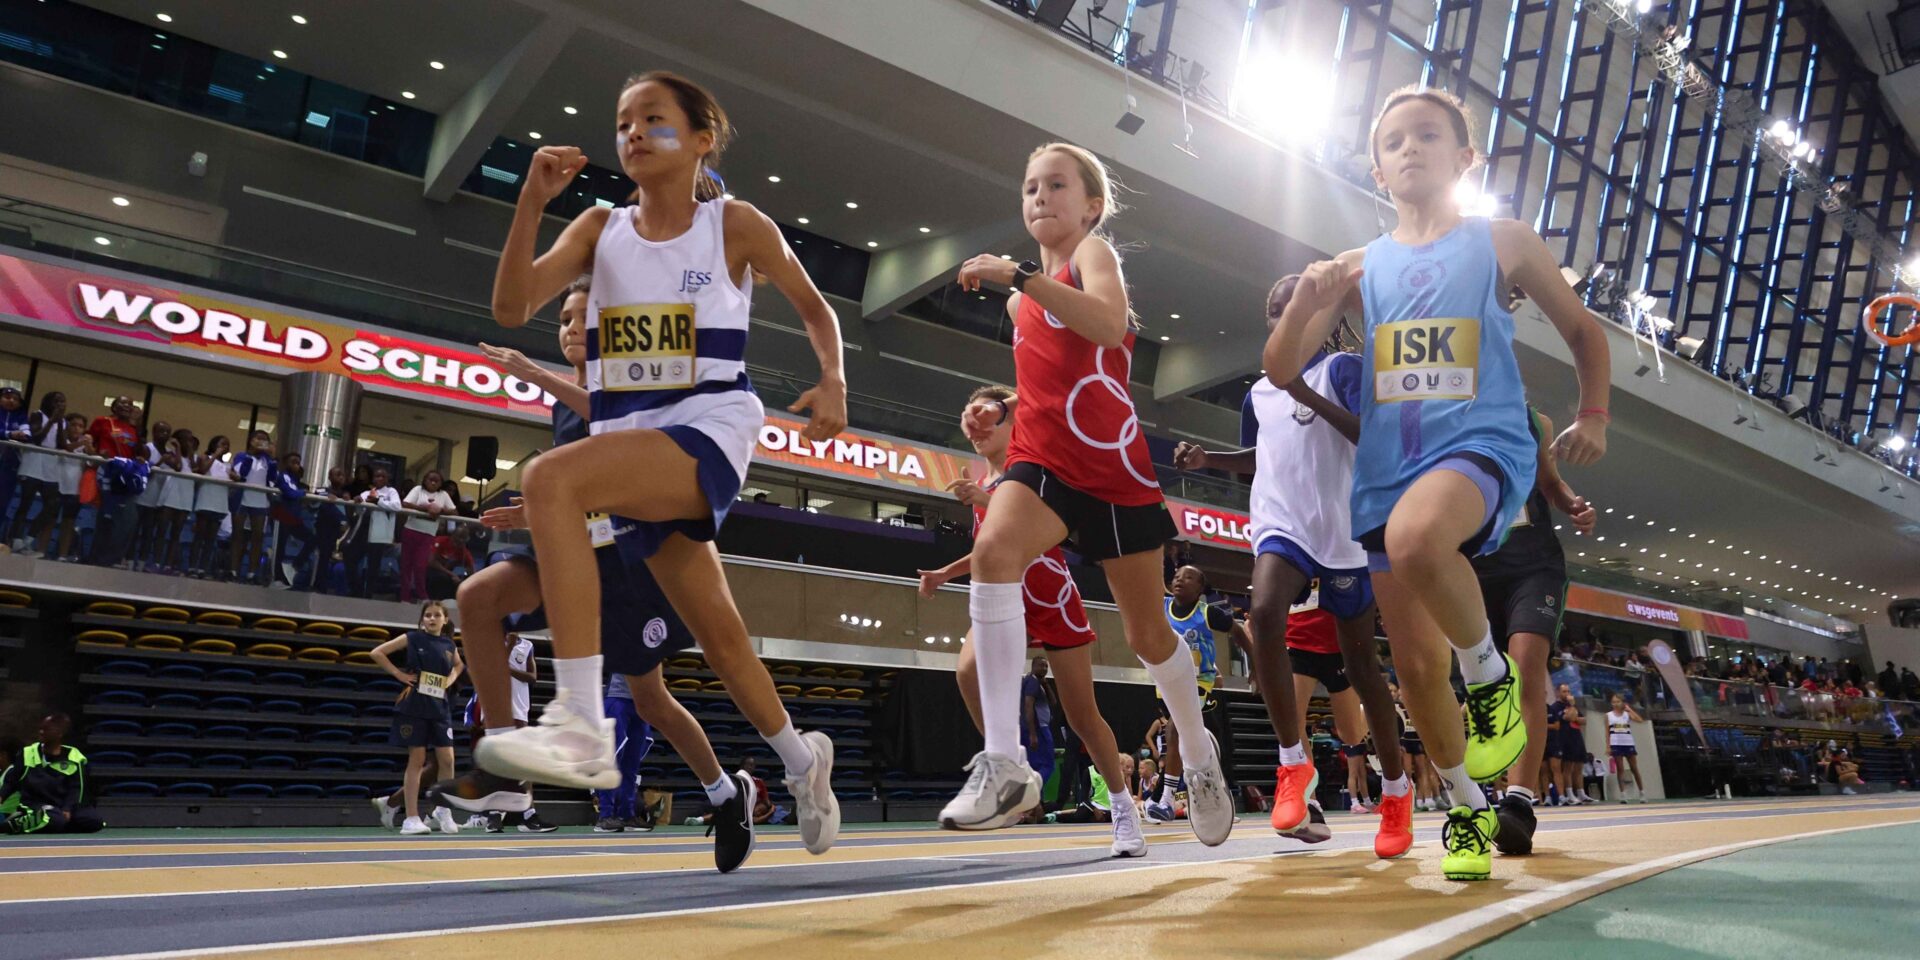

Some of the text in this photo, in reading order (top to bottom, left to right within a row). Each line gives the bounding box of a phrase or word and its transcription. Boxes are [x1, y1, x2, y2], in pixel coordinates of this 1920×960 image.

[678, 269, 712, 292] JESS
[603, 314, 692, 354] JESS AR
[1393, 326, 1456, 366] ISK
[79, 283, 328, 359] WORLD
[758, 425, 926, 479] OLYMPIA
[425, 674, 443, 688] ISM
